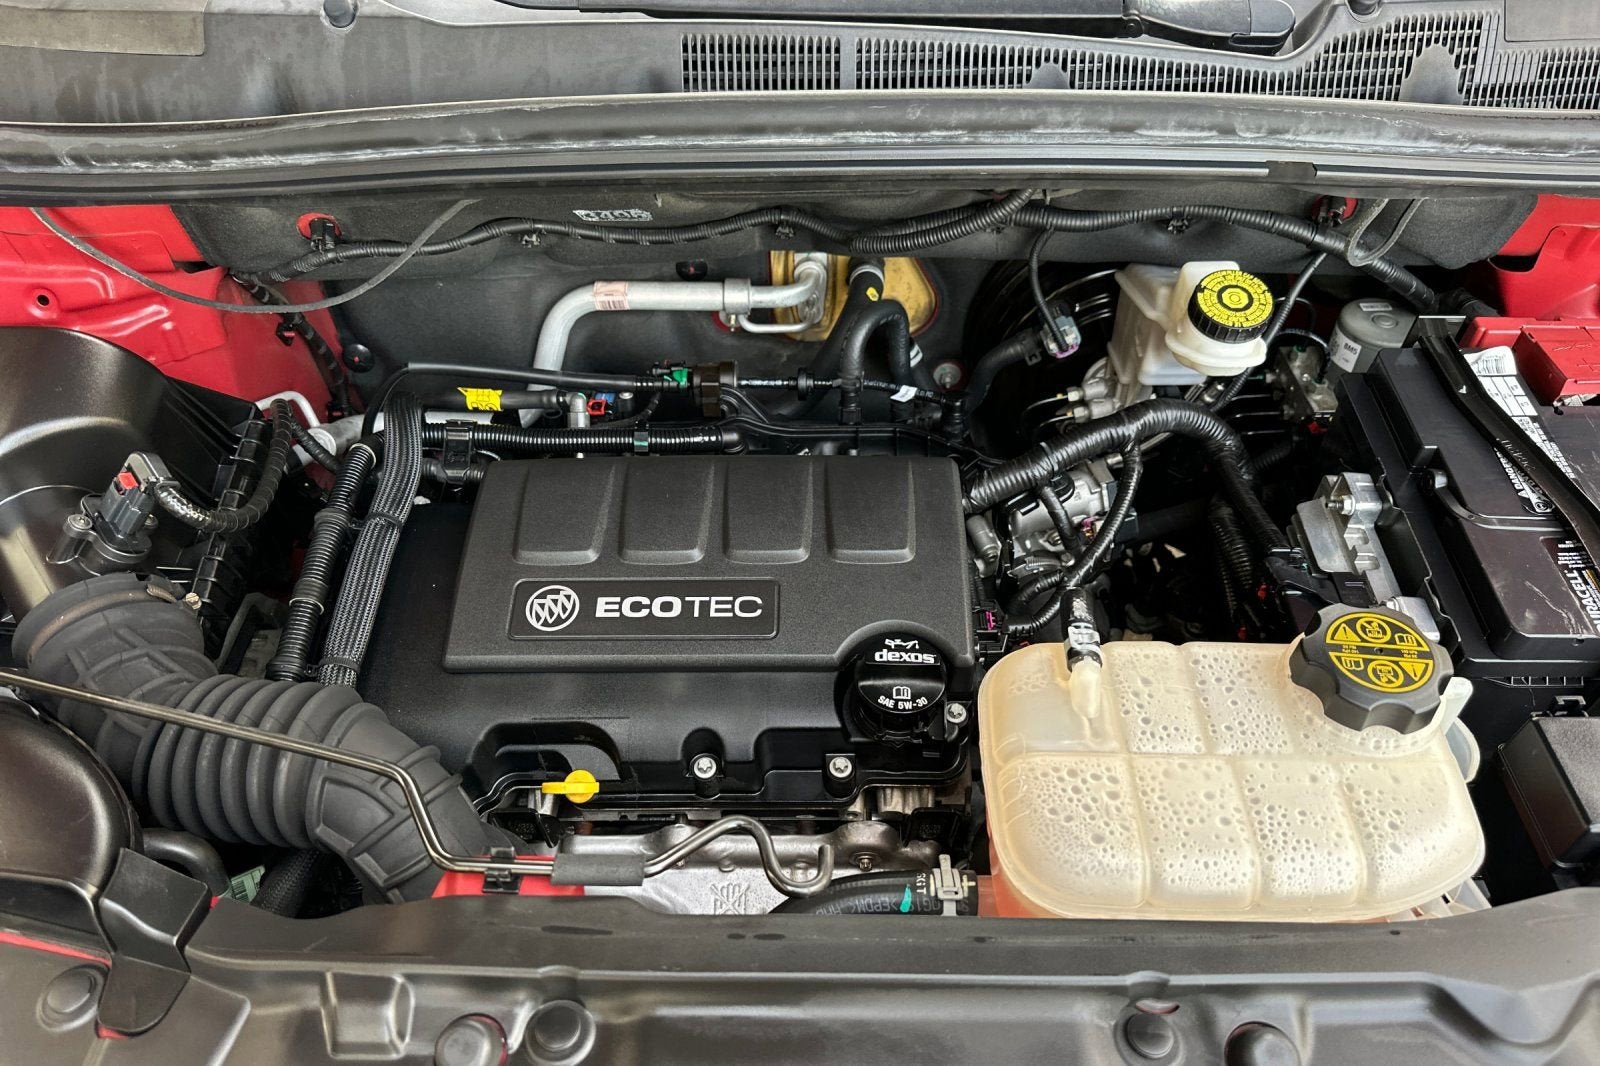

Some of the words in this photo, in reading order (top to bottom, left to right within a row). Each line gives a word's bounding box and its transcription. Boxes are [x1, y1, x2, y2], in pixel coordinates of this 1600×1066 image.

[595, 596, 763, 618] ECOTEC
[874, 649, 936, 664] dexos
[878, 695, 895, 709] SAE
[897, 696, 928, 710] 5W-30
